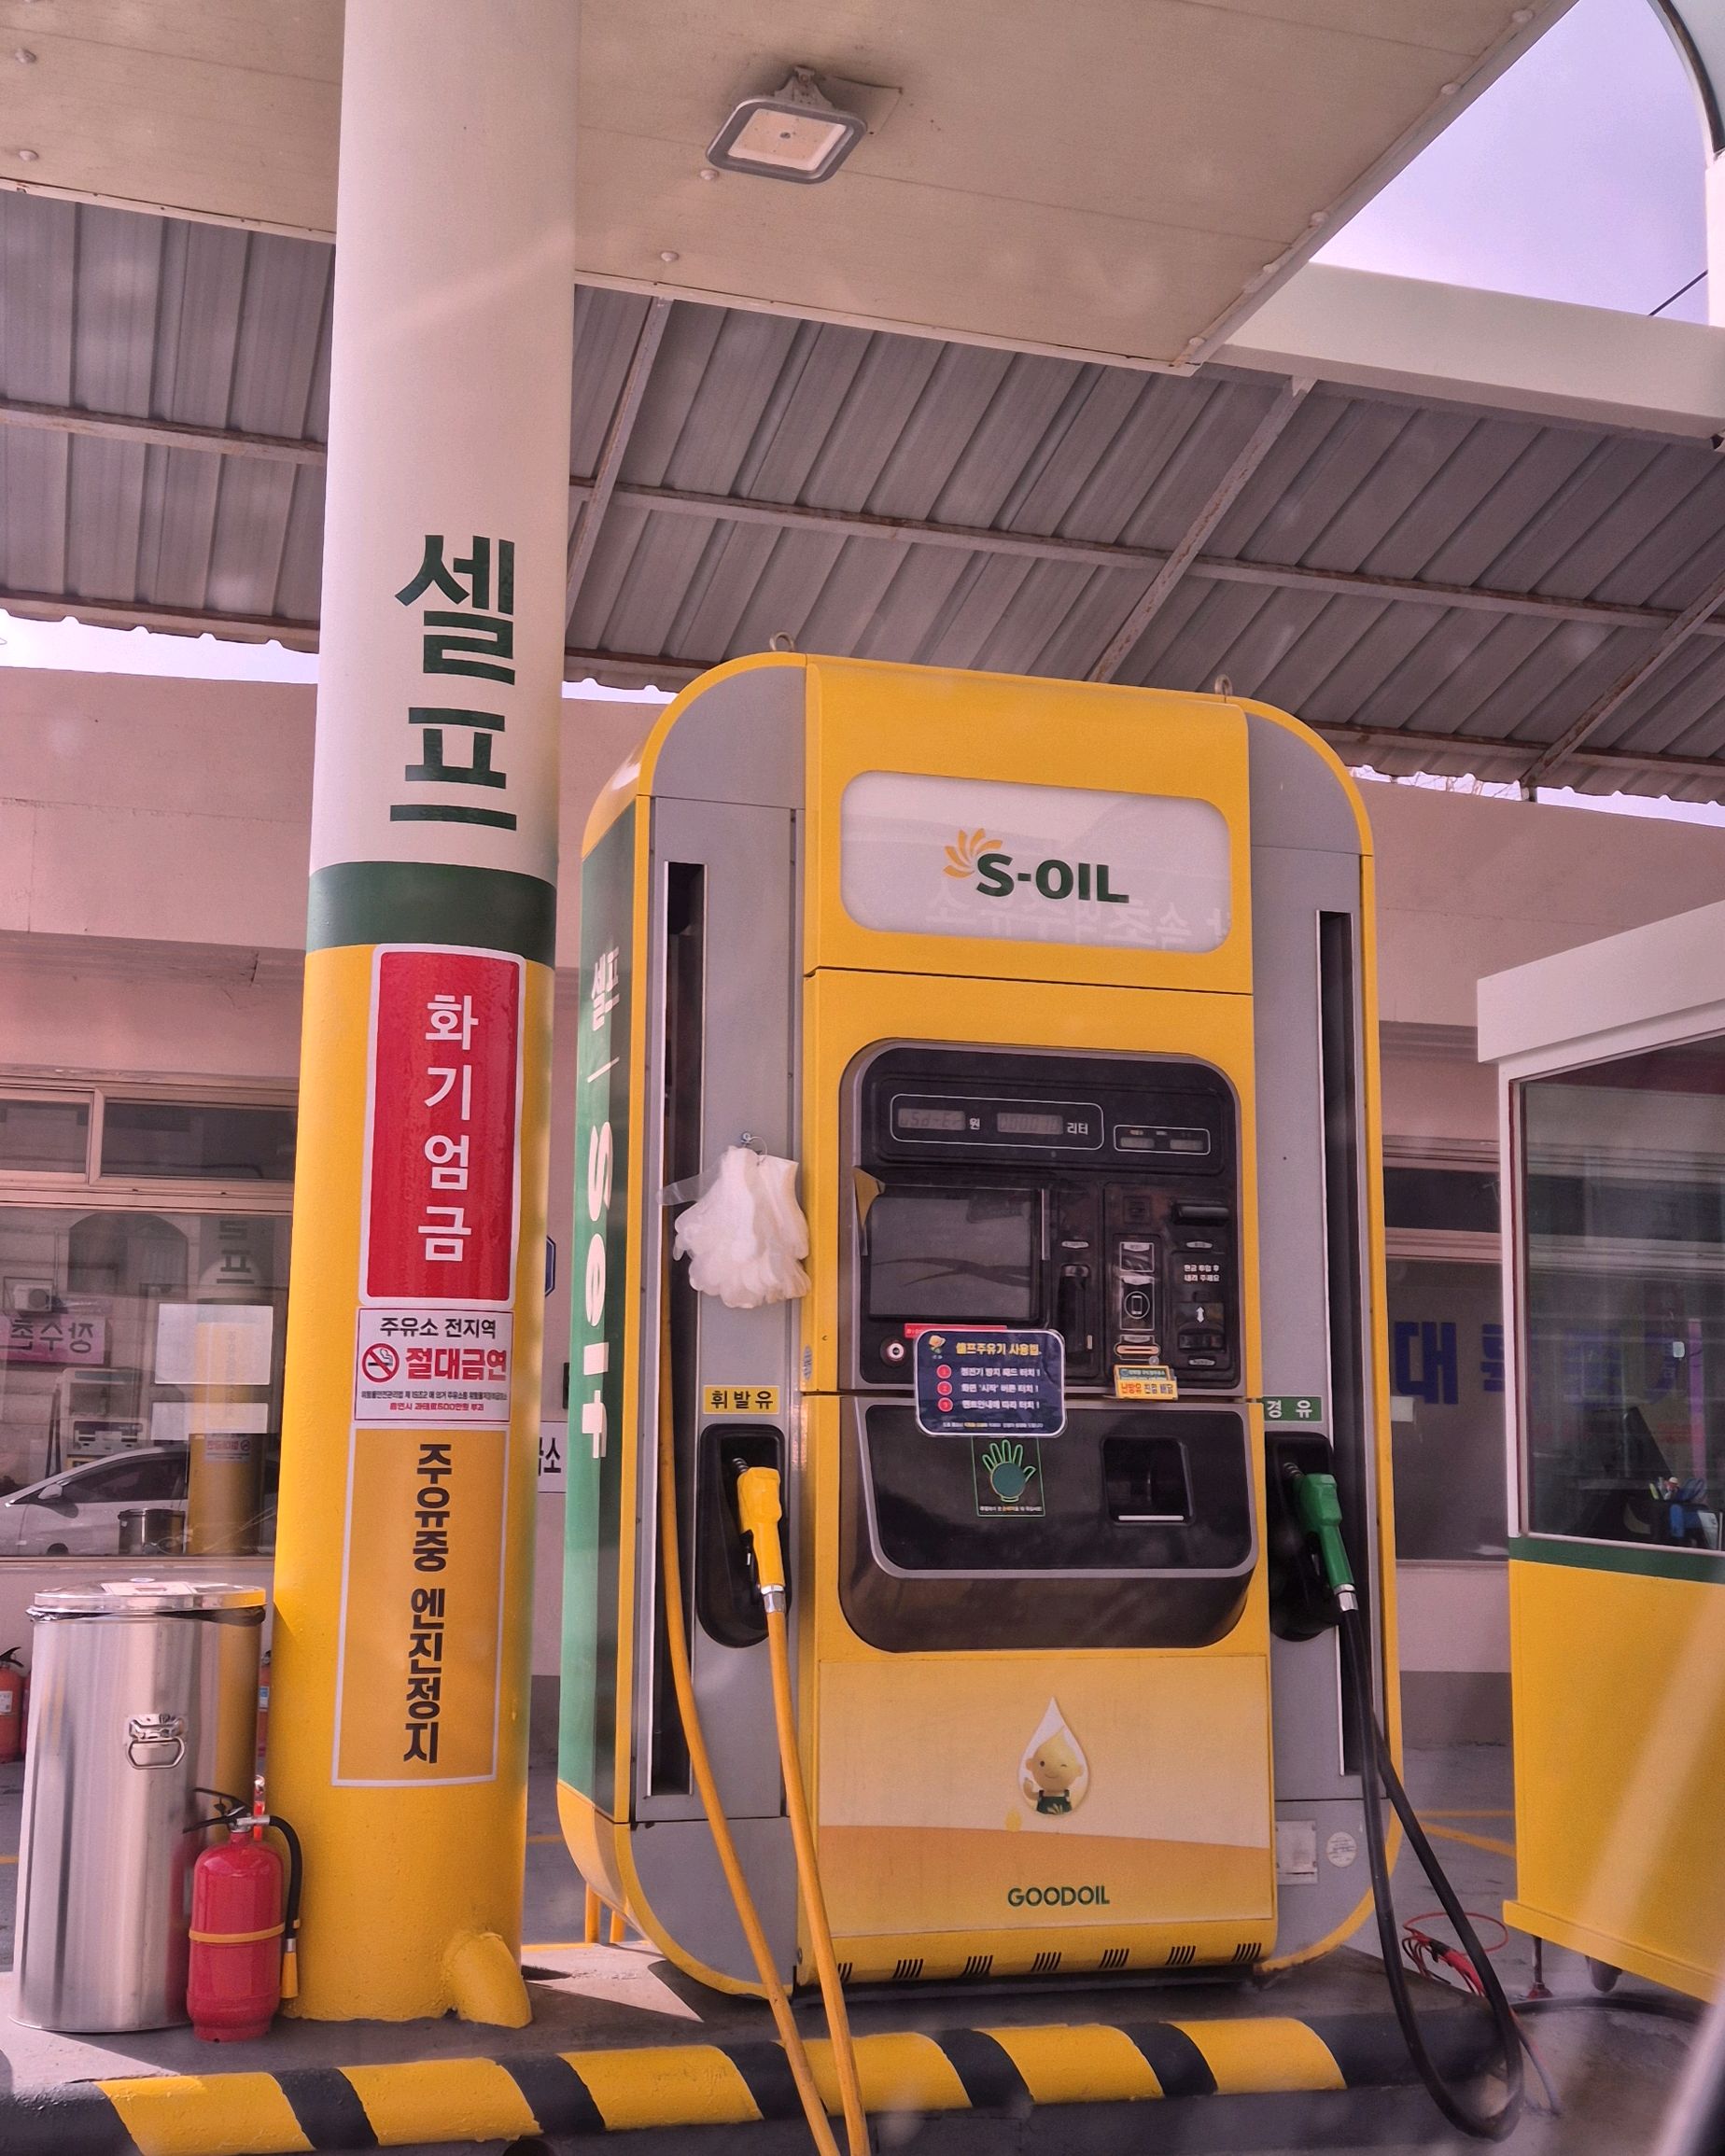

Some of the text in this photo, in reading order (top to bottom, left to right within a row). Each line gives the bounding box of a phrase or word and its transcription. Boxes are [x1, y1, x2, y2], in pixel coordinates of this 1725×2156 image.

[390, 535, 517, 831] 셀프
[976, 853, 1129, 904] S-OIL
[591, 945, 621, 1032] 셀프
[418, 995, 479, 1262] 화기엄금
[1067, 1122, 1088, 1136] 리터
[582, 1121, 614, 1460] Self
[380, 1317, 496, 1339] 주유소 전지역
[956, 1342, 1006, 1355] 셀프주유기
[405, 1348, 508, 1381] 절대금연
[711, 1391, 774, 1409] 휘발유
[1267, 1400, 1312, 1419] 경유
[413, 1444, 453, 1573] 주유중
[403, 1588, 446, 1764] 엔진정지
[1007, 1885, 1111, 1907] GOODOIL
